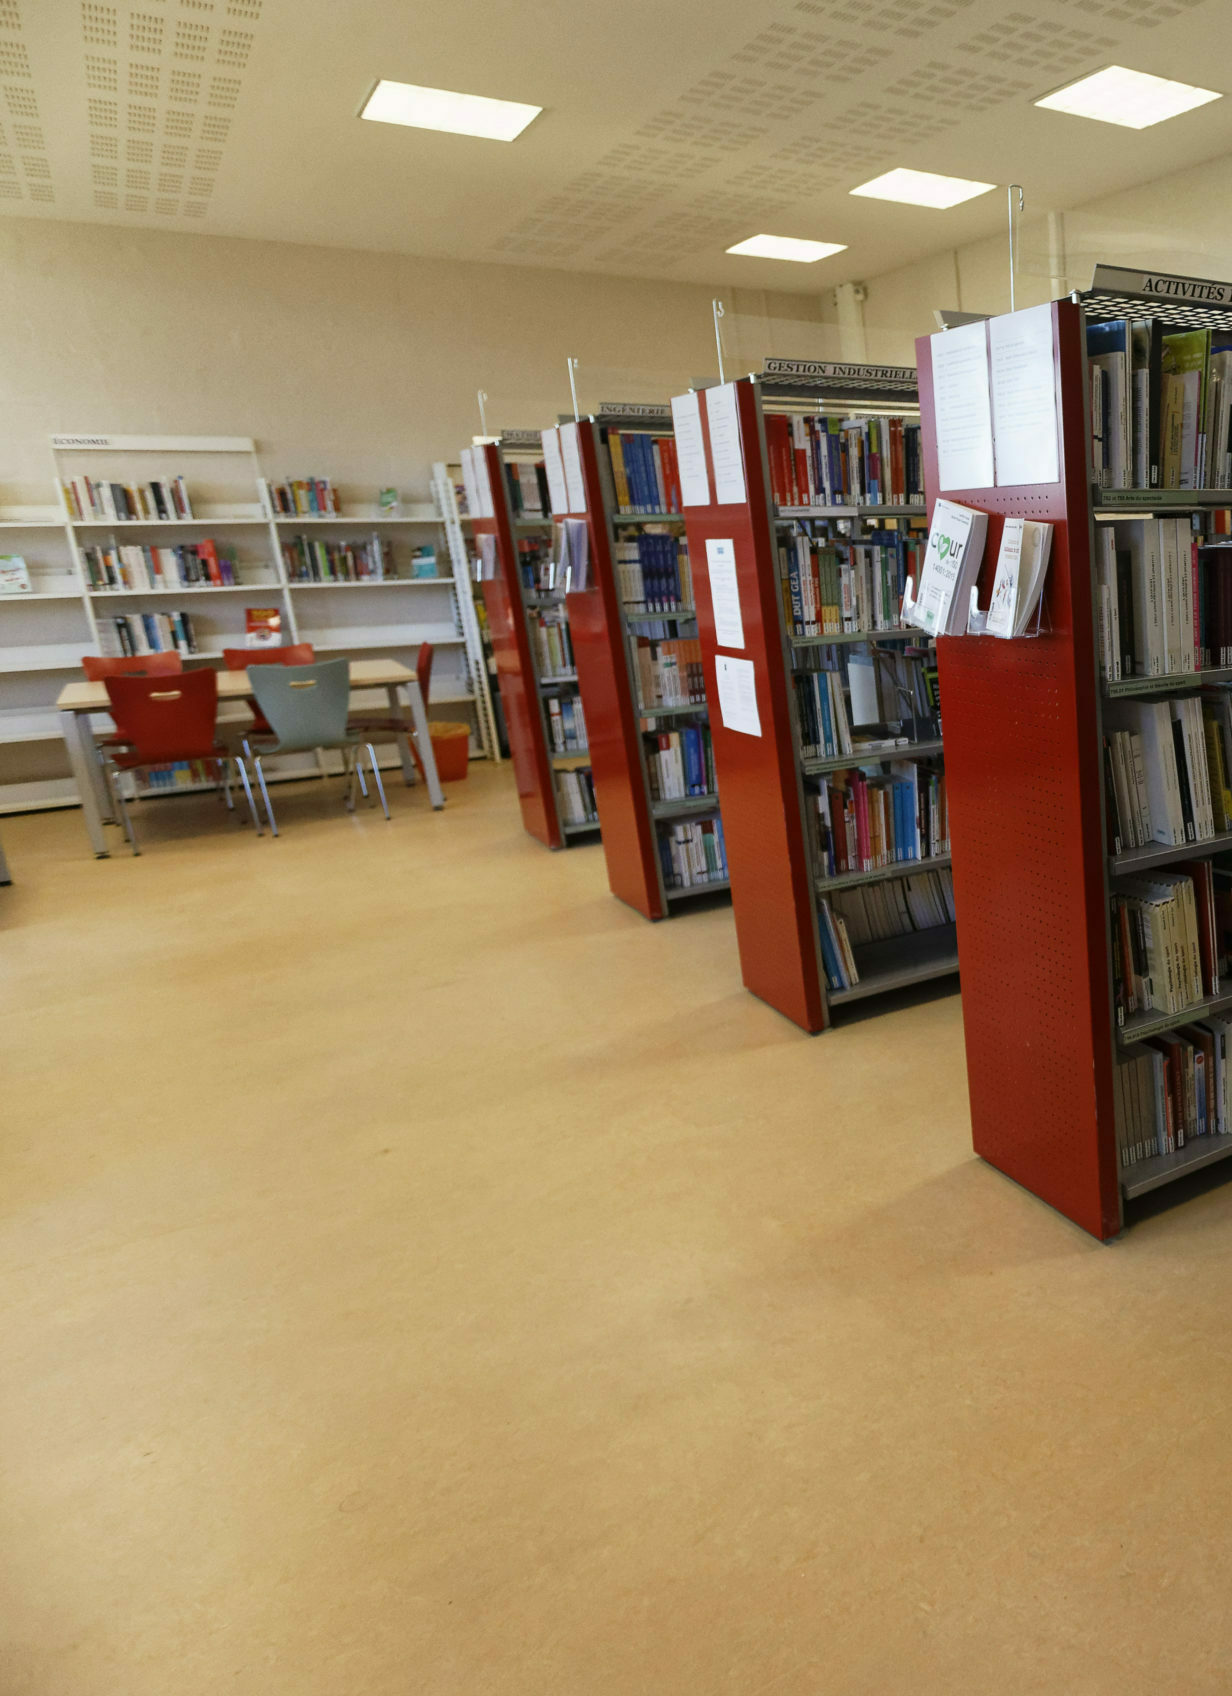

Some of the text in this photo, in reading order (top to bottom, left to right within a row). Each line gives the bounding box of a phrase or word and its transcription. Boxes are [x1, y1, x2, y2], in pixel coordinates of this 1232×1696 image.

[1143, 277, 1225, 301] ACTIVITÉS
[767, 361, 917, 380] GESTION INDUSTRIELL
[790, 571, 801, 617] DUT GEA
